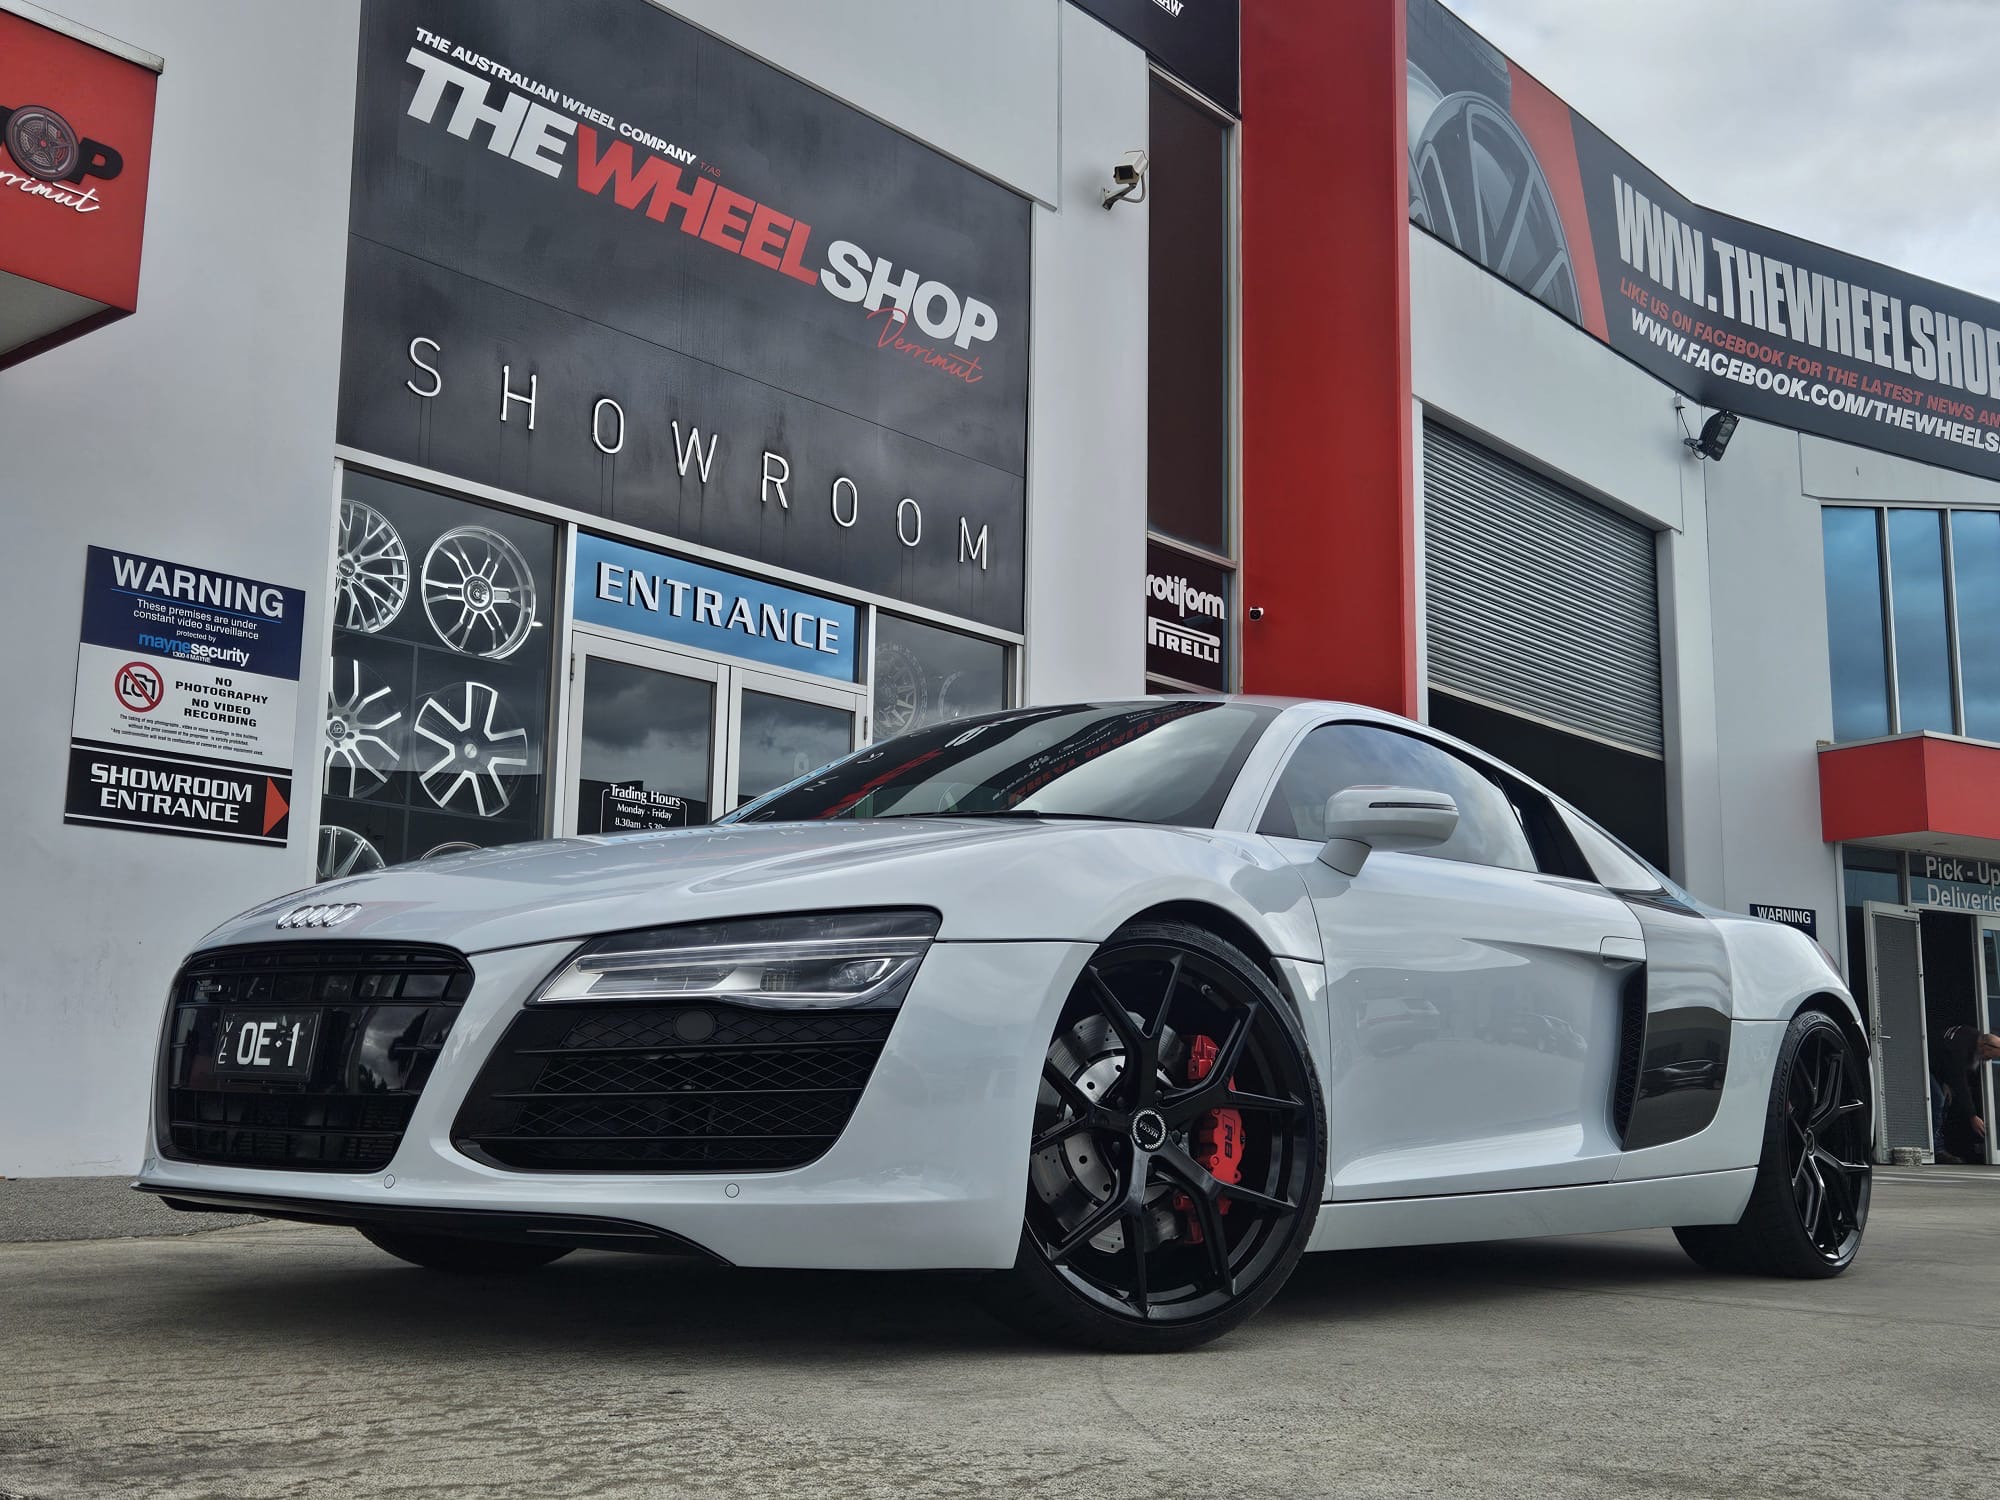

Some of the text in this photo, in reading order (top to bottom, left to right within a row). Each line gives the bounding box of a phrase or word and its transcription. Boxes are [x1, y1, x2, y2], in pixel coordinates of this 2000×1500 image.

[416, 27, 451, 54] THE
[451, 46, 559, 103] AUSTRALIAN
[562, 94, 616, 131] WHEEL
[619, 121, 696, 165] COMPANY
[1620, 276, 1649, 309] LIKE
[1651, 295, 1669, 321] US
[1671, 310, 1692, 334] ON
[1693, 321, 1786, 368] FACEBOOK
[1786, 354, 1822, 378] FOR
[1826, 365, 1859, 388] THE
[1861, 375, 1924, 406] LATEST
[1926, 394, 1975, 421] NEWS
[1631, 307, 2000, 453] WWW.FACEBOOK.COM/THEWHEELS
[112, 555, 284, 618] WARNING
[1146, 574, 1225, 620] rotiform
[133, 608, 259, 640] constant video surveillance
[137, 598, 258, 631] These premises are under
[597, 561, 840, 655] ENTRANCE
[176, 629, 217, 644] protected by
[1148, 616, 1220, 663] PIRELLI
[175, 680, 269, 705] PHOTOGRAPHY
[215, 676, 233, 688] NO
[184, 707, 257, 728] RECORDING
[191, 697, 251, 716] NO VIDEO
[90, 761, 252, 803] SHOWROOM
[610, 783, 681, 807] Trading Hours
[100, 787, 239, 824] ENTRANCE
[616, 803, 645, 818] Monday
[652, 808, 673, 822] Friday
[1925, 856, 1964, 882] Pick
[1757, 906, 1811, 924] WARNING
